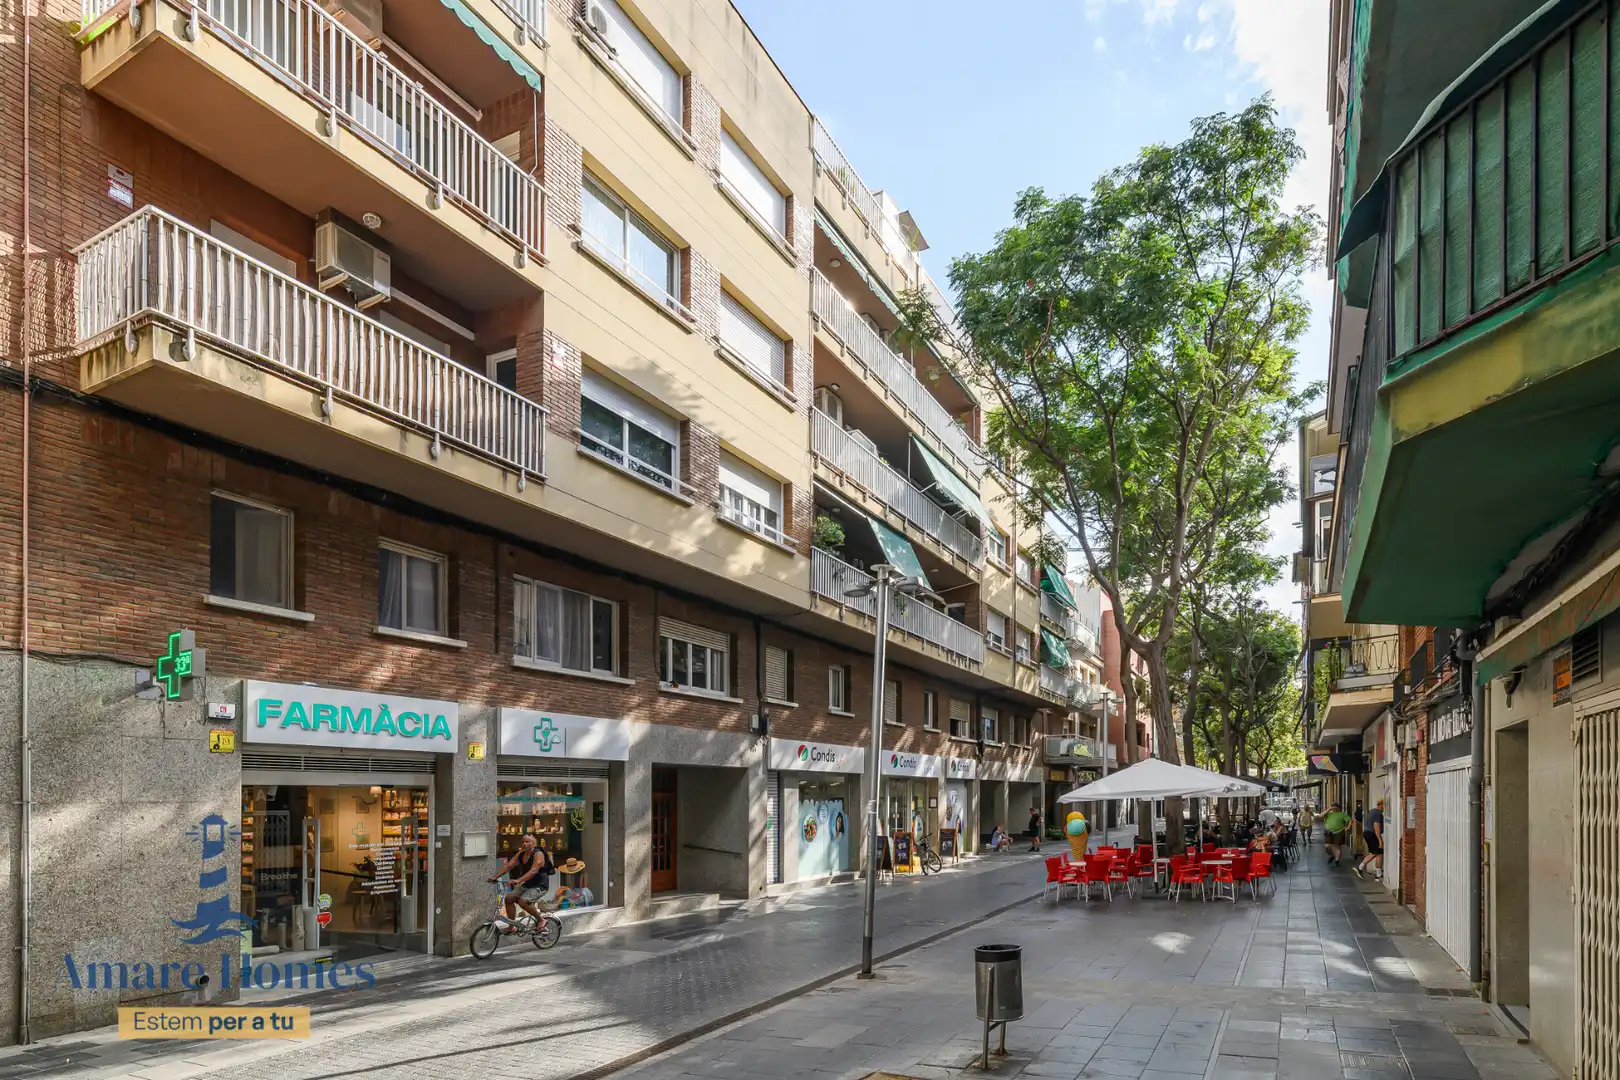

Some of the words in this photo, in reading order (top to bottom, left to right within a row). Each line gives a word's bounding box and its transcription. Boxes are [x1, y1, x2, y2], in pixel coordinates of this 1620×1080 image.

[257, 698, 452, 740] FARMÀCIA
[811, 747, 836, 763] Condis
[261, 871, 298, 882] Breathe
